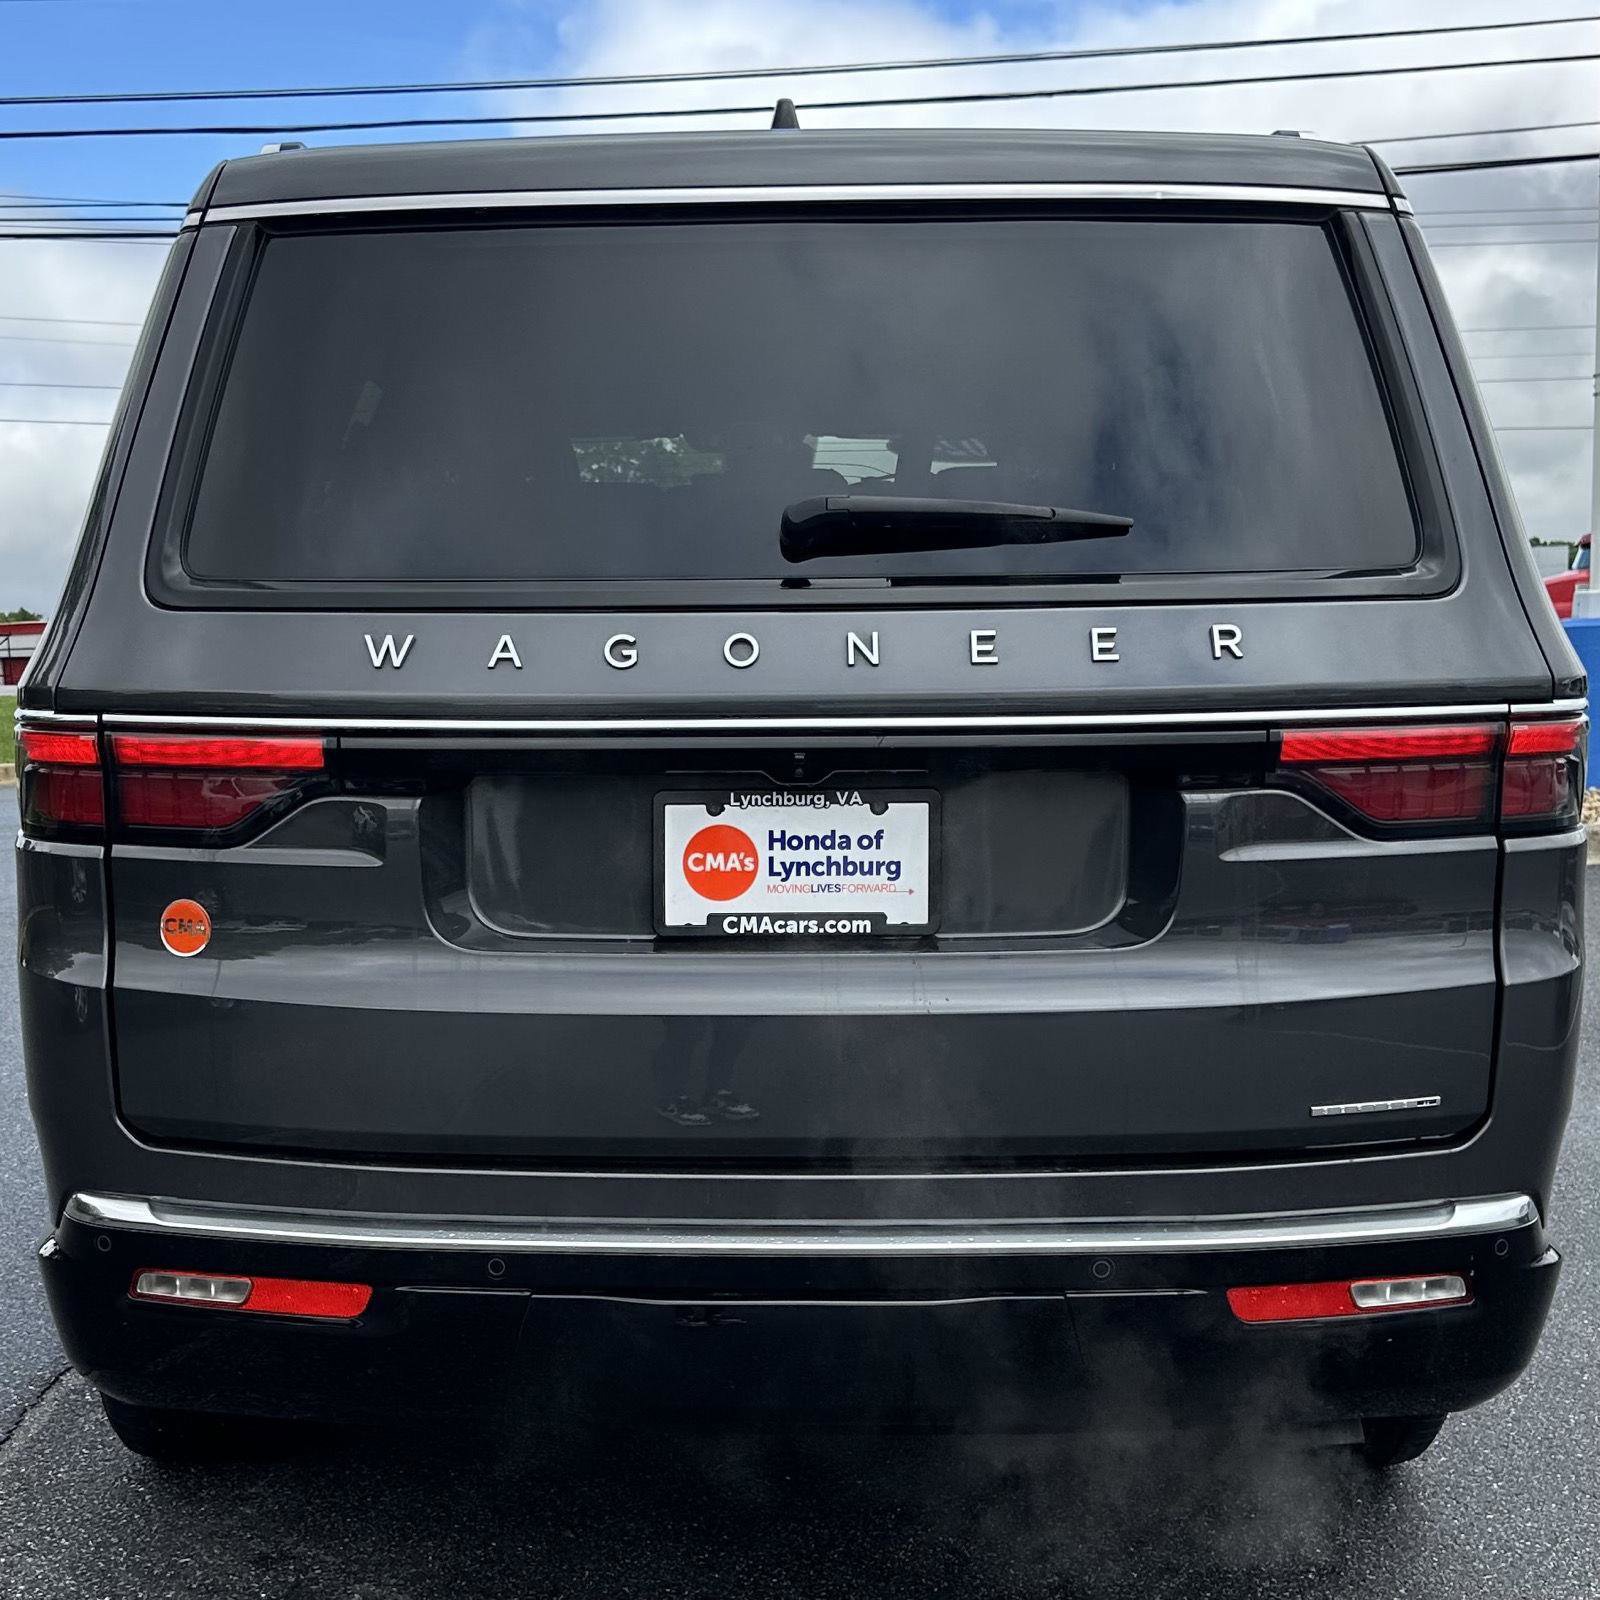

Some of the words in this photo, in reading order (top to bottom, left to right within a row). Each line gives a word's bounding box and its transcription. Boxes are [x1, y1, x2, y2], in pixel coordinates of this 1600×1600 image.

[364, 623, 1244, 670] WAGONEER
[729, 791, 830, 808] Lynchburg,
[836, 791, 863, 806] VA
[768, 829, 851, 851] Honda
[857, 829, 884, 850] of
[687, 852, 755, 872] CMA's
[768, 856, 901, 881] Lynchburg
[722, 916, 872, 934] CMAcars.com
